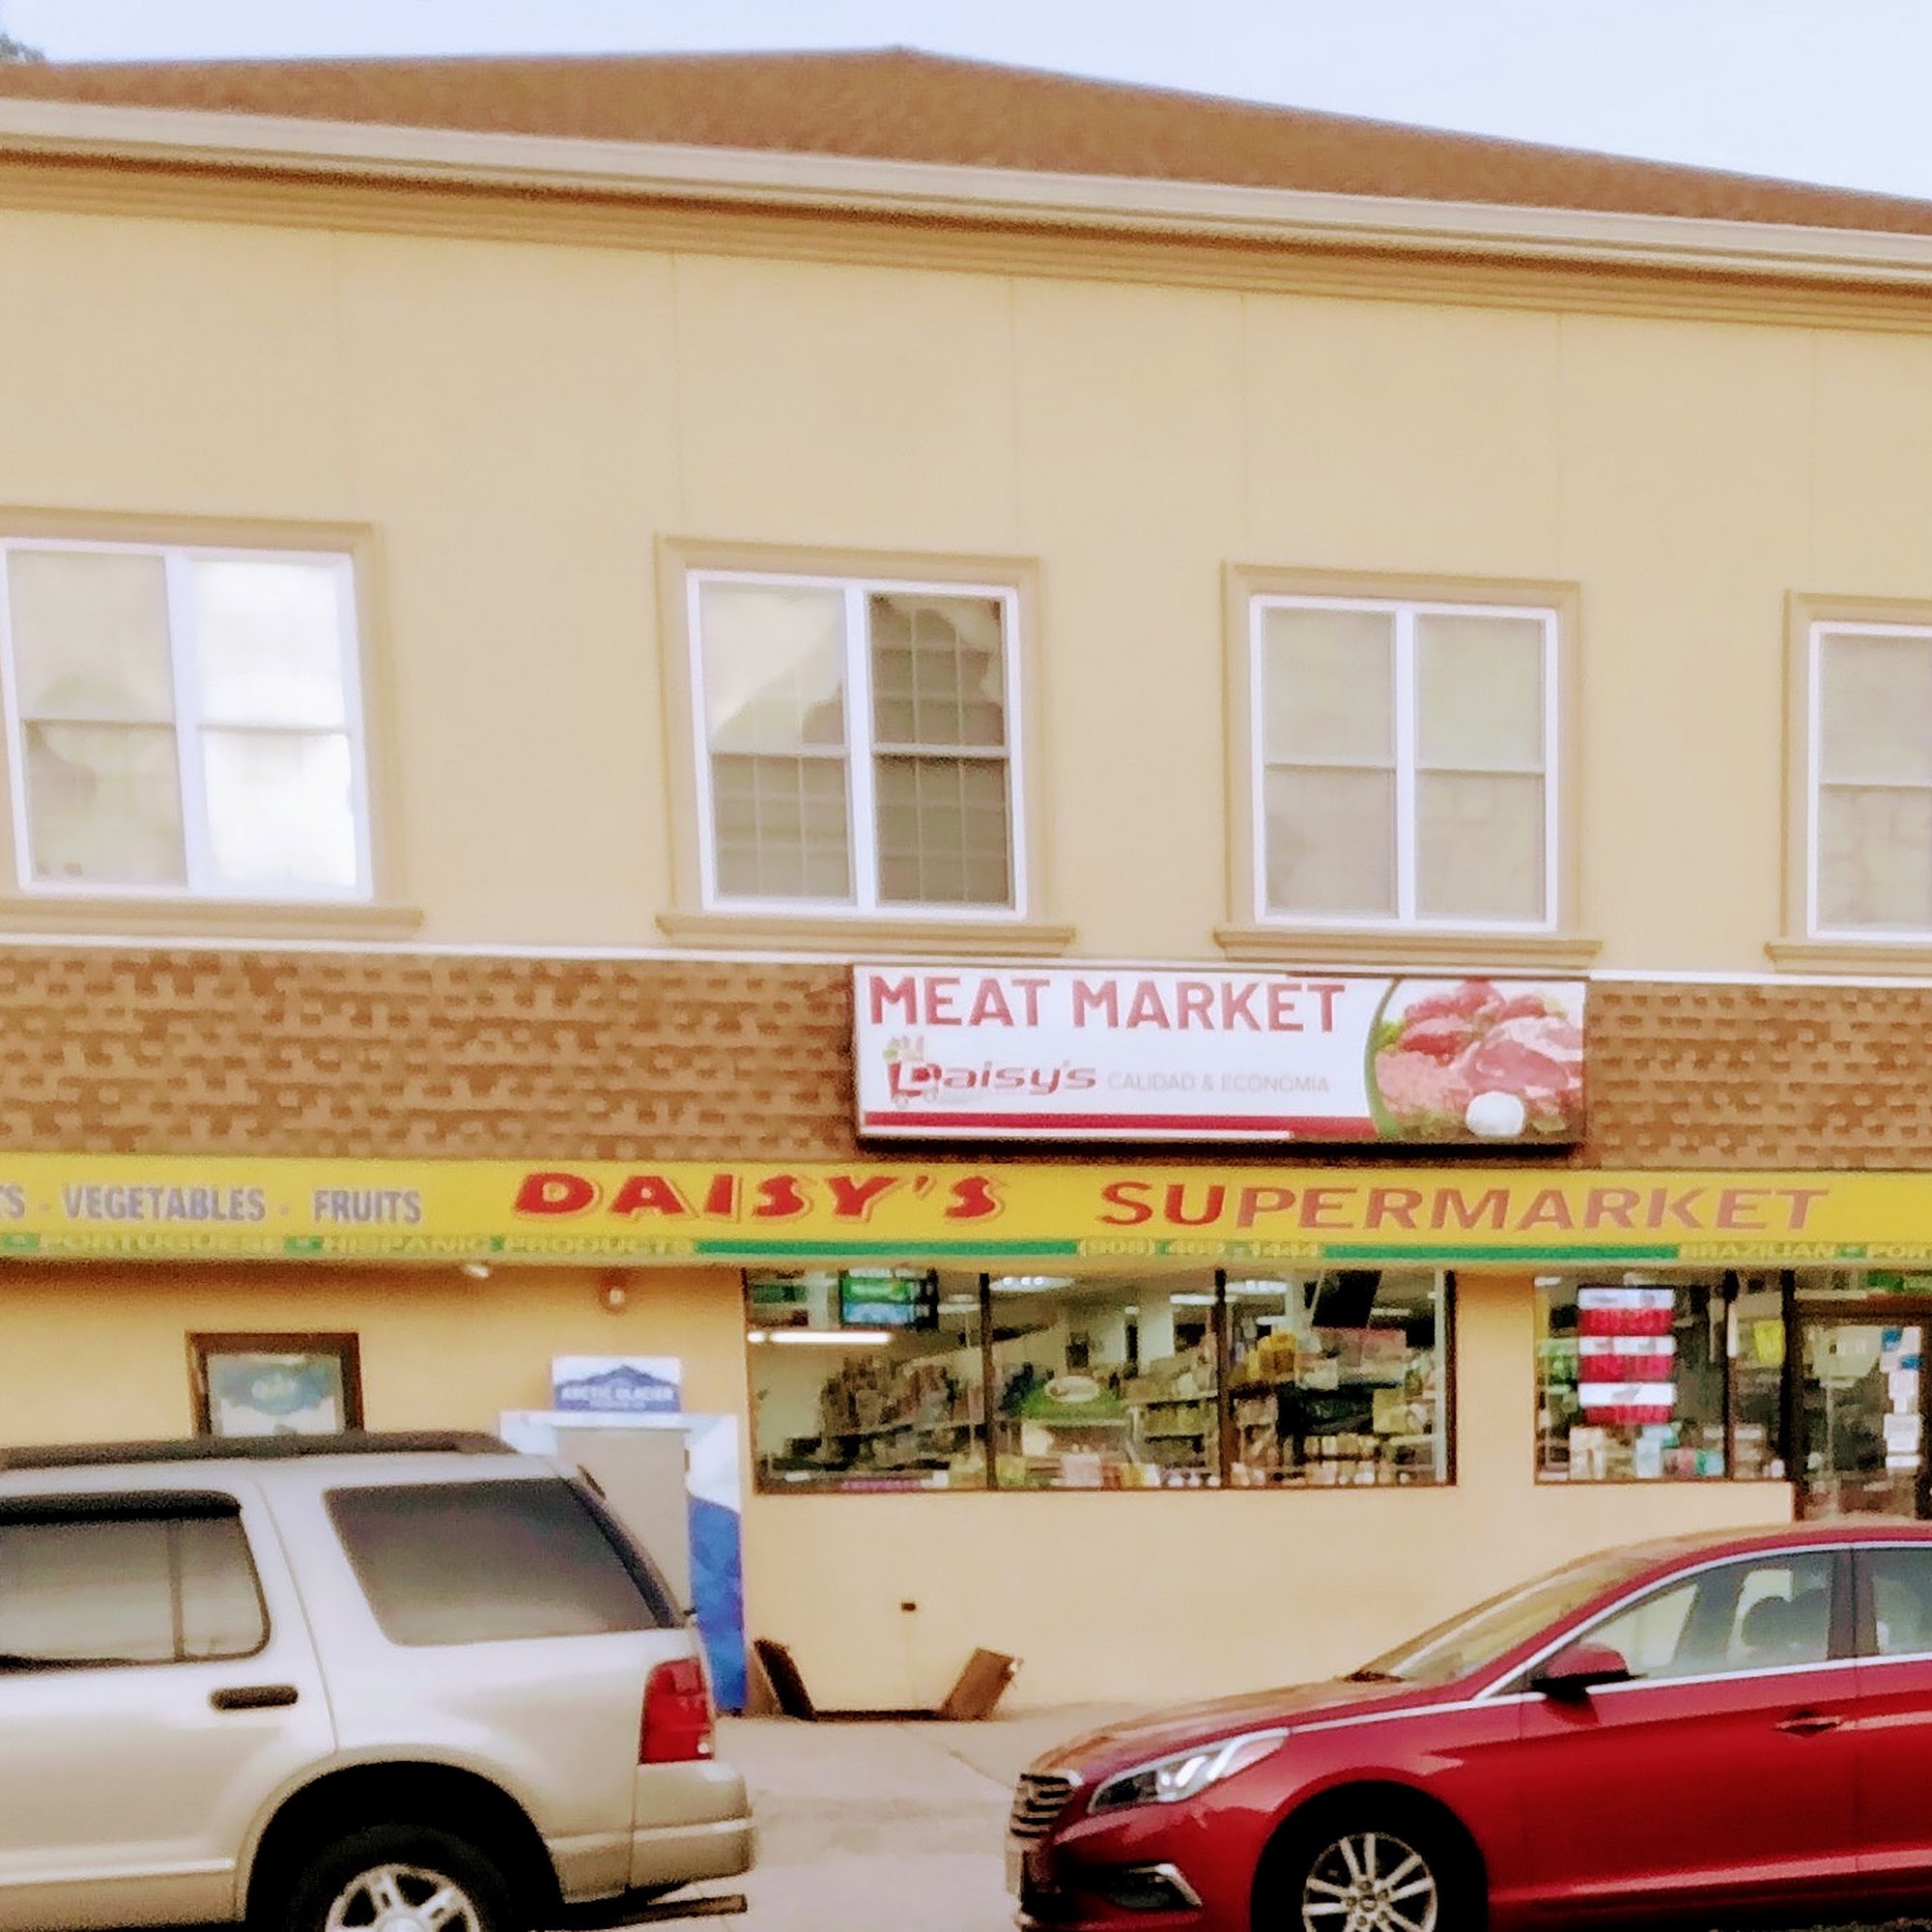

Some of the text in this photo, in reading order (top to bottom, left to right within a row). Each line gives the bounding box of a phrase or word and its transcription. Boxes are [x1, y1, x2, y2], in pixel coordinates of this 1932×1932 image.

[869, 976, 1346, 1034] MEAT MARKET
[1107, 1071, 1196, 1092] CALIDAD
[61, 1184, 267, 1222] VEGETABLES
[312, 1189, 422, 1223] FRUITS
[514, 1172, 1830, 1231] DAISY'S SUPERMARKET
